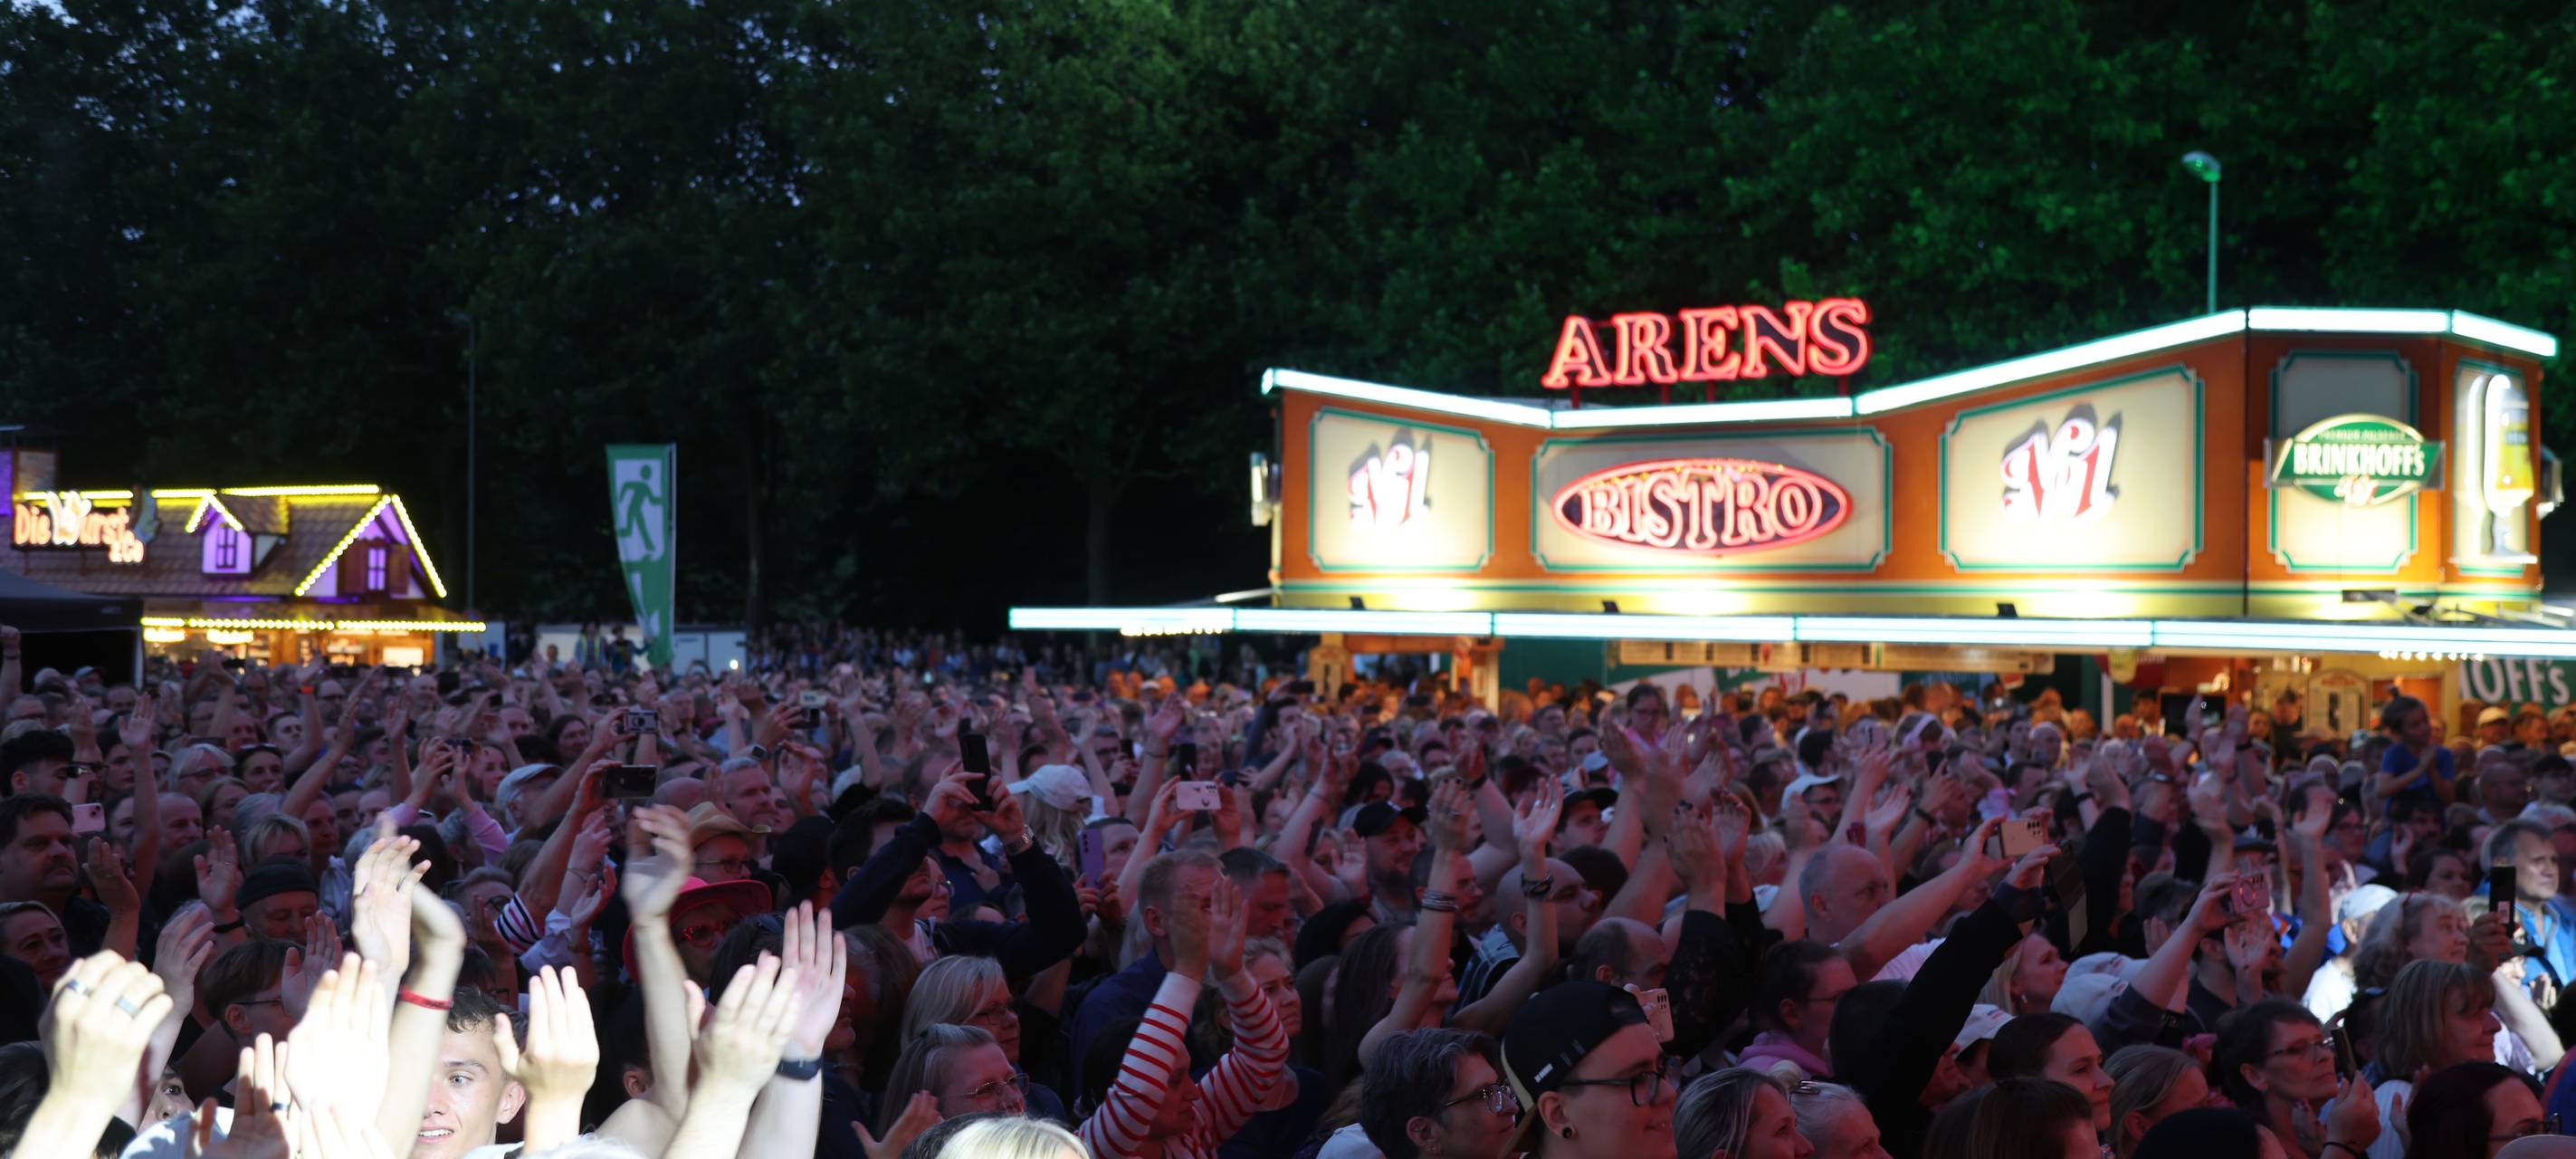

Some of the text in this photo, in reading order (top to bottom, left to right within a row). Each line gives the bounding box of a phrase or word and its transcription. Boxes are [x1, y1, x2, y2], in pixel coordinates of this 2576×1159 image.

[1541, 297, 1872, 389] ARENS
[2293, 443, 2426, 477] BRINKHOFF's
[14, 490, 130, 545] Die Wurst
[1578, 468, 1823, 550] BISTRO
